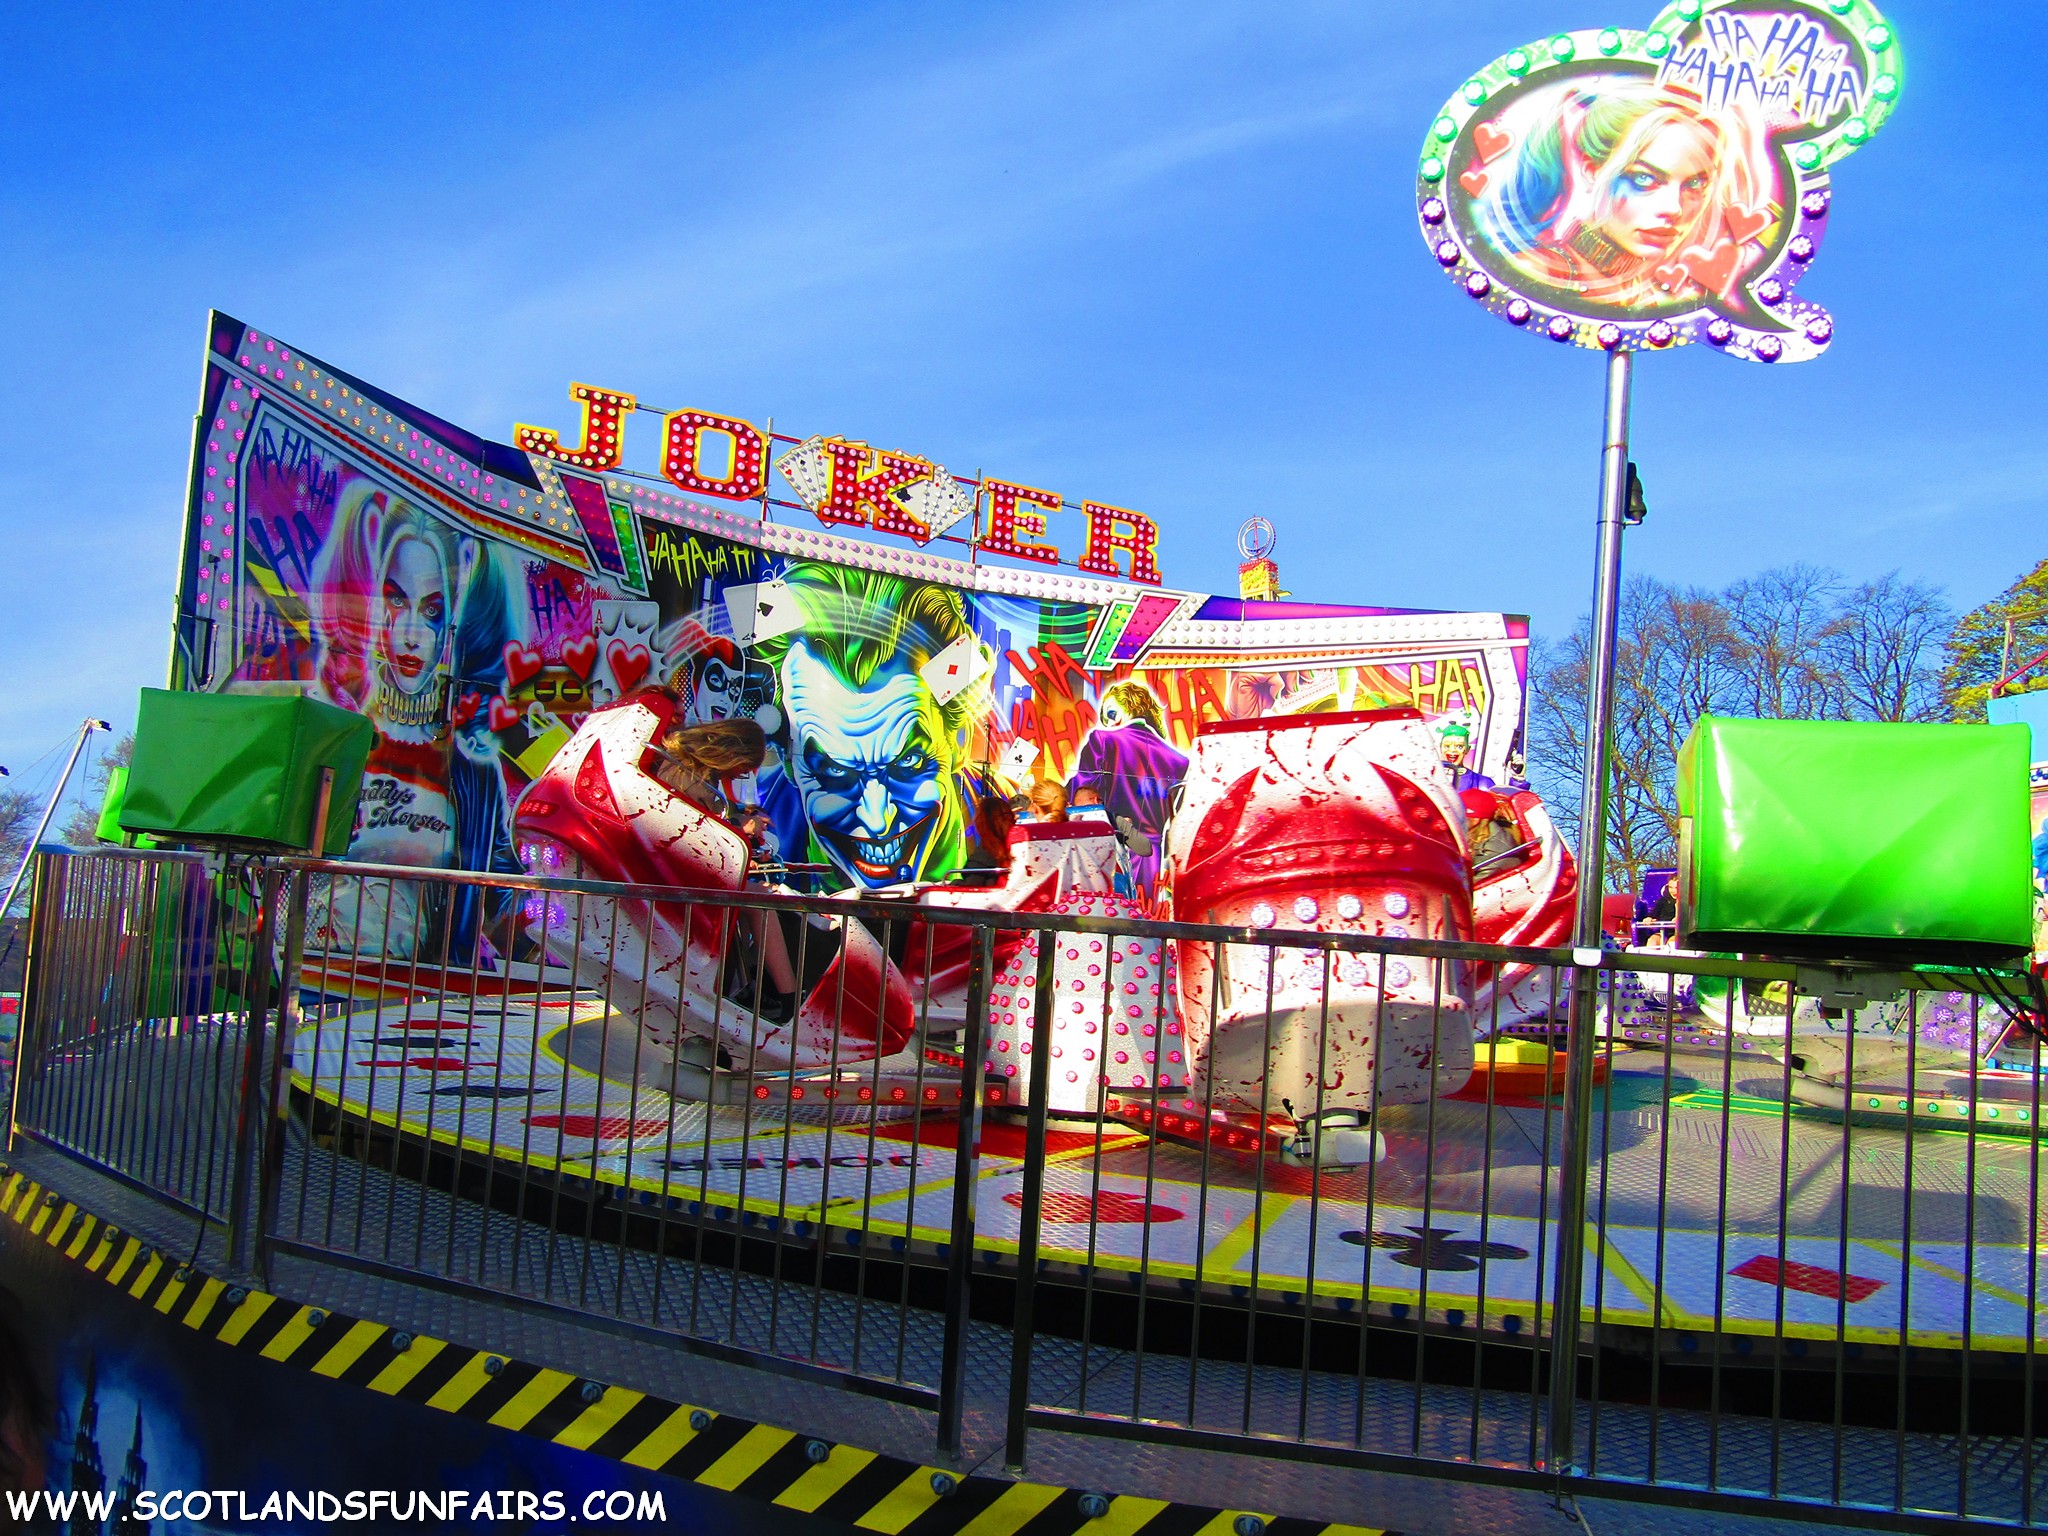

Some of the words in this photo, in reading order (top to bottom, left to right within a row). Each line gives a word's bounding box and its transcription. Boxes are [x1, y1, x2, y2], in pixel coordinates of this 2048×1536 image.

[1659, 43, 1708, 86] HA
[1706, 60, 1760, 111] HA
[1758, 79, 1790, 107] HA
[1802, 67, 1859, 123] HA
[1704, 15, 1760, 59] HA
[1759, 17, 1819, 86] HA
[1808, 47, 1843, 69] HA
[513, 381, 1162, 585] JOKER
[249, 510, 322, 597] HA
[529, 577, 577, 639] HA
[1004, 640, 1096, 705] HA
[1156, 669, 1229, 750] HA
[359, 778, 419, 807] addy's
[366, 805, 451, 835] Monster
